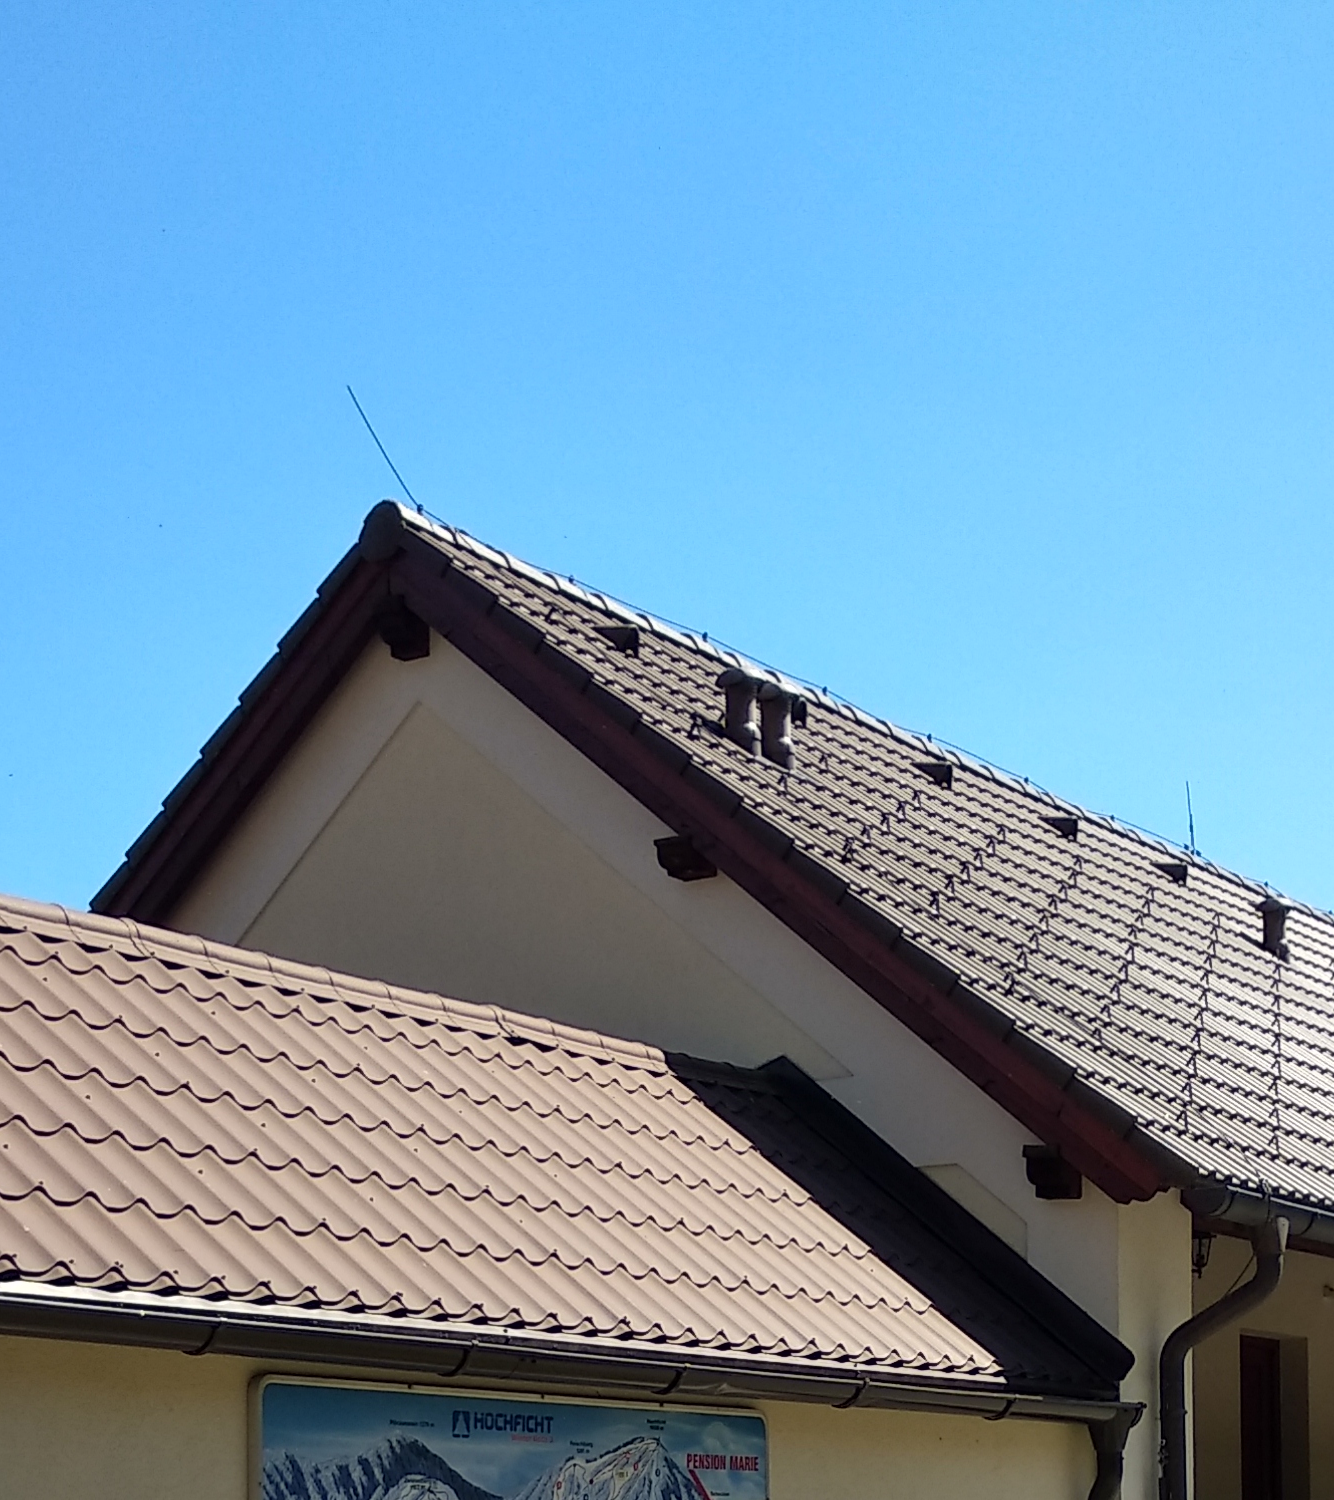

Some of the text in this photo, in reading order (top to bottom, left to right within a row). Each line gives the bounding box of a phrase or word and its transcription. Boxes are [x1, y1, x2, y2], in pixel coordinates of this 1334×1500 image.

[473, 1411, 555, 1435] HOCHFICHT
[686, 1452, 760, 1472] PENSION MARIE
